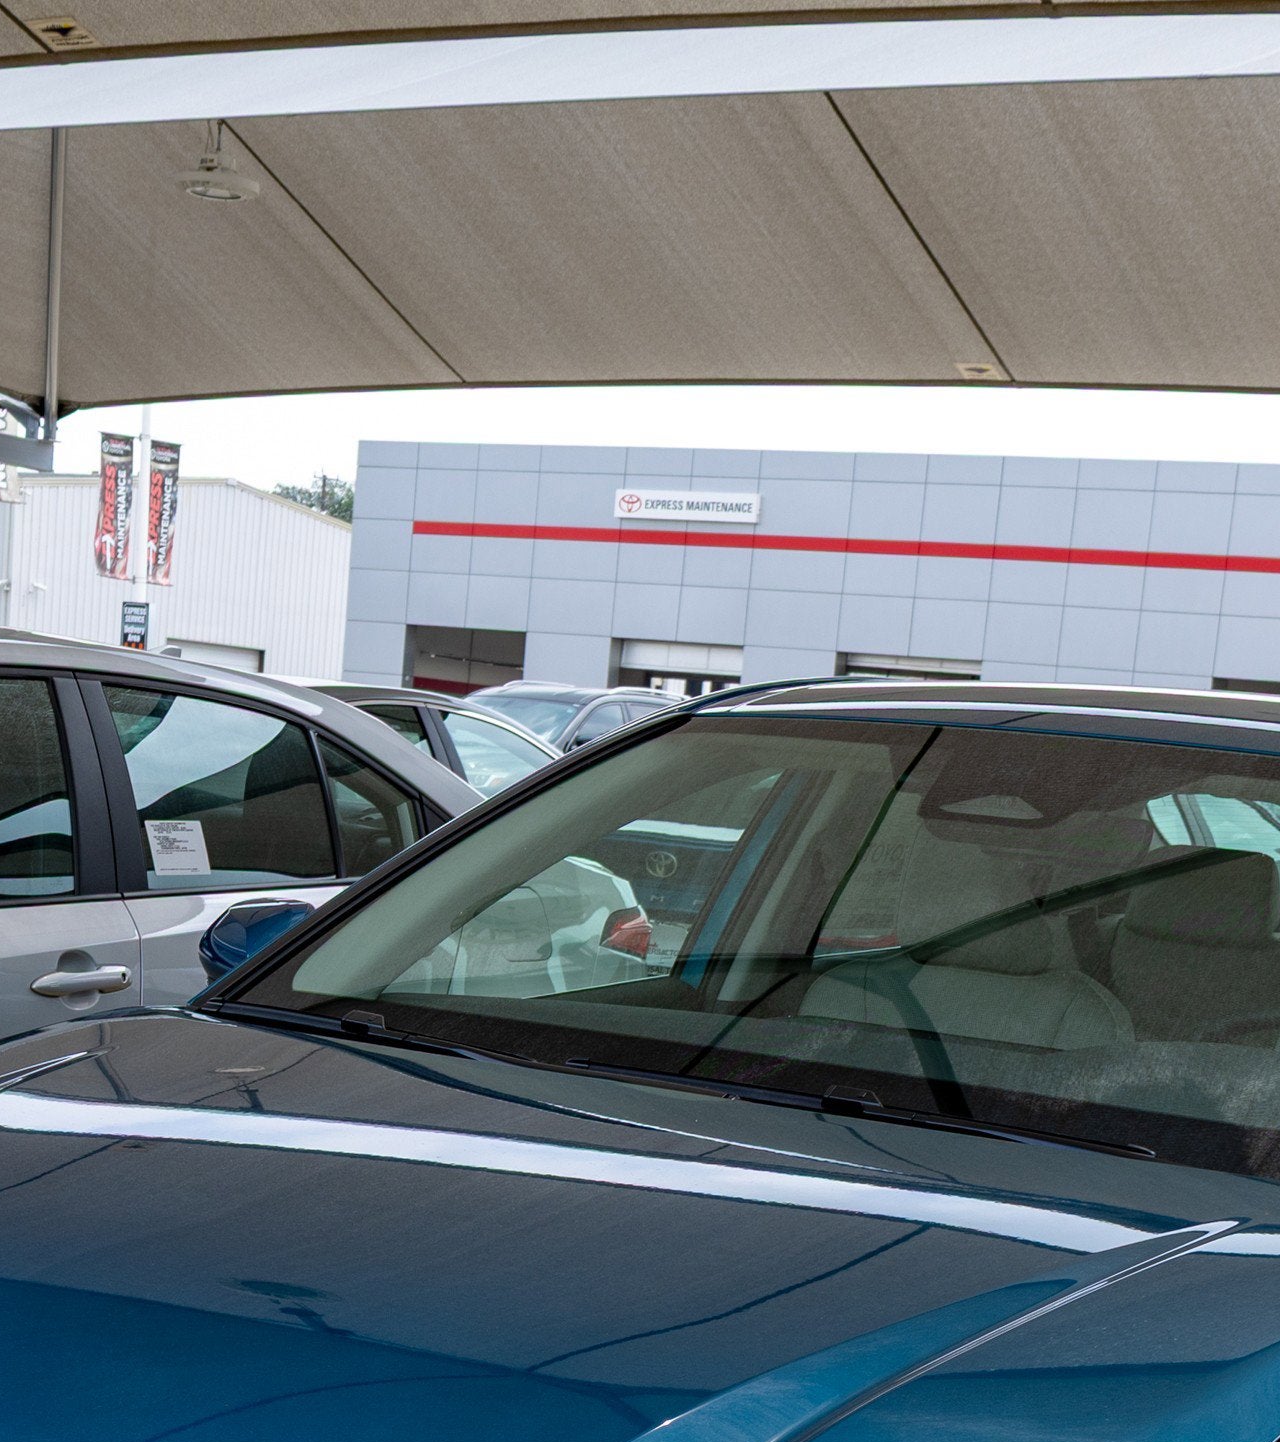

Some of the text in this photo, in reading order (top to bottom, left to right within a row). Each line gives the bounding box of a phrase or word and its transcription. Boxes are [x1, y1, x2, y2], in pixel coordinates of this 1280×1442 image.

[116, 469, 128, 559] MAINTENANCE
[157, 477, 174, 566] MAINTENANCE
[644, 499, 753, 513] EXPRESS MAINTENANCE
